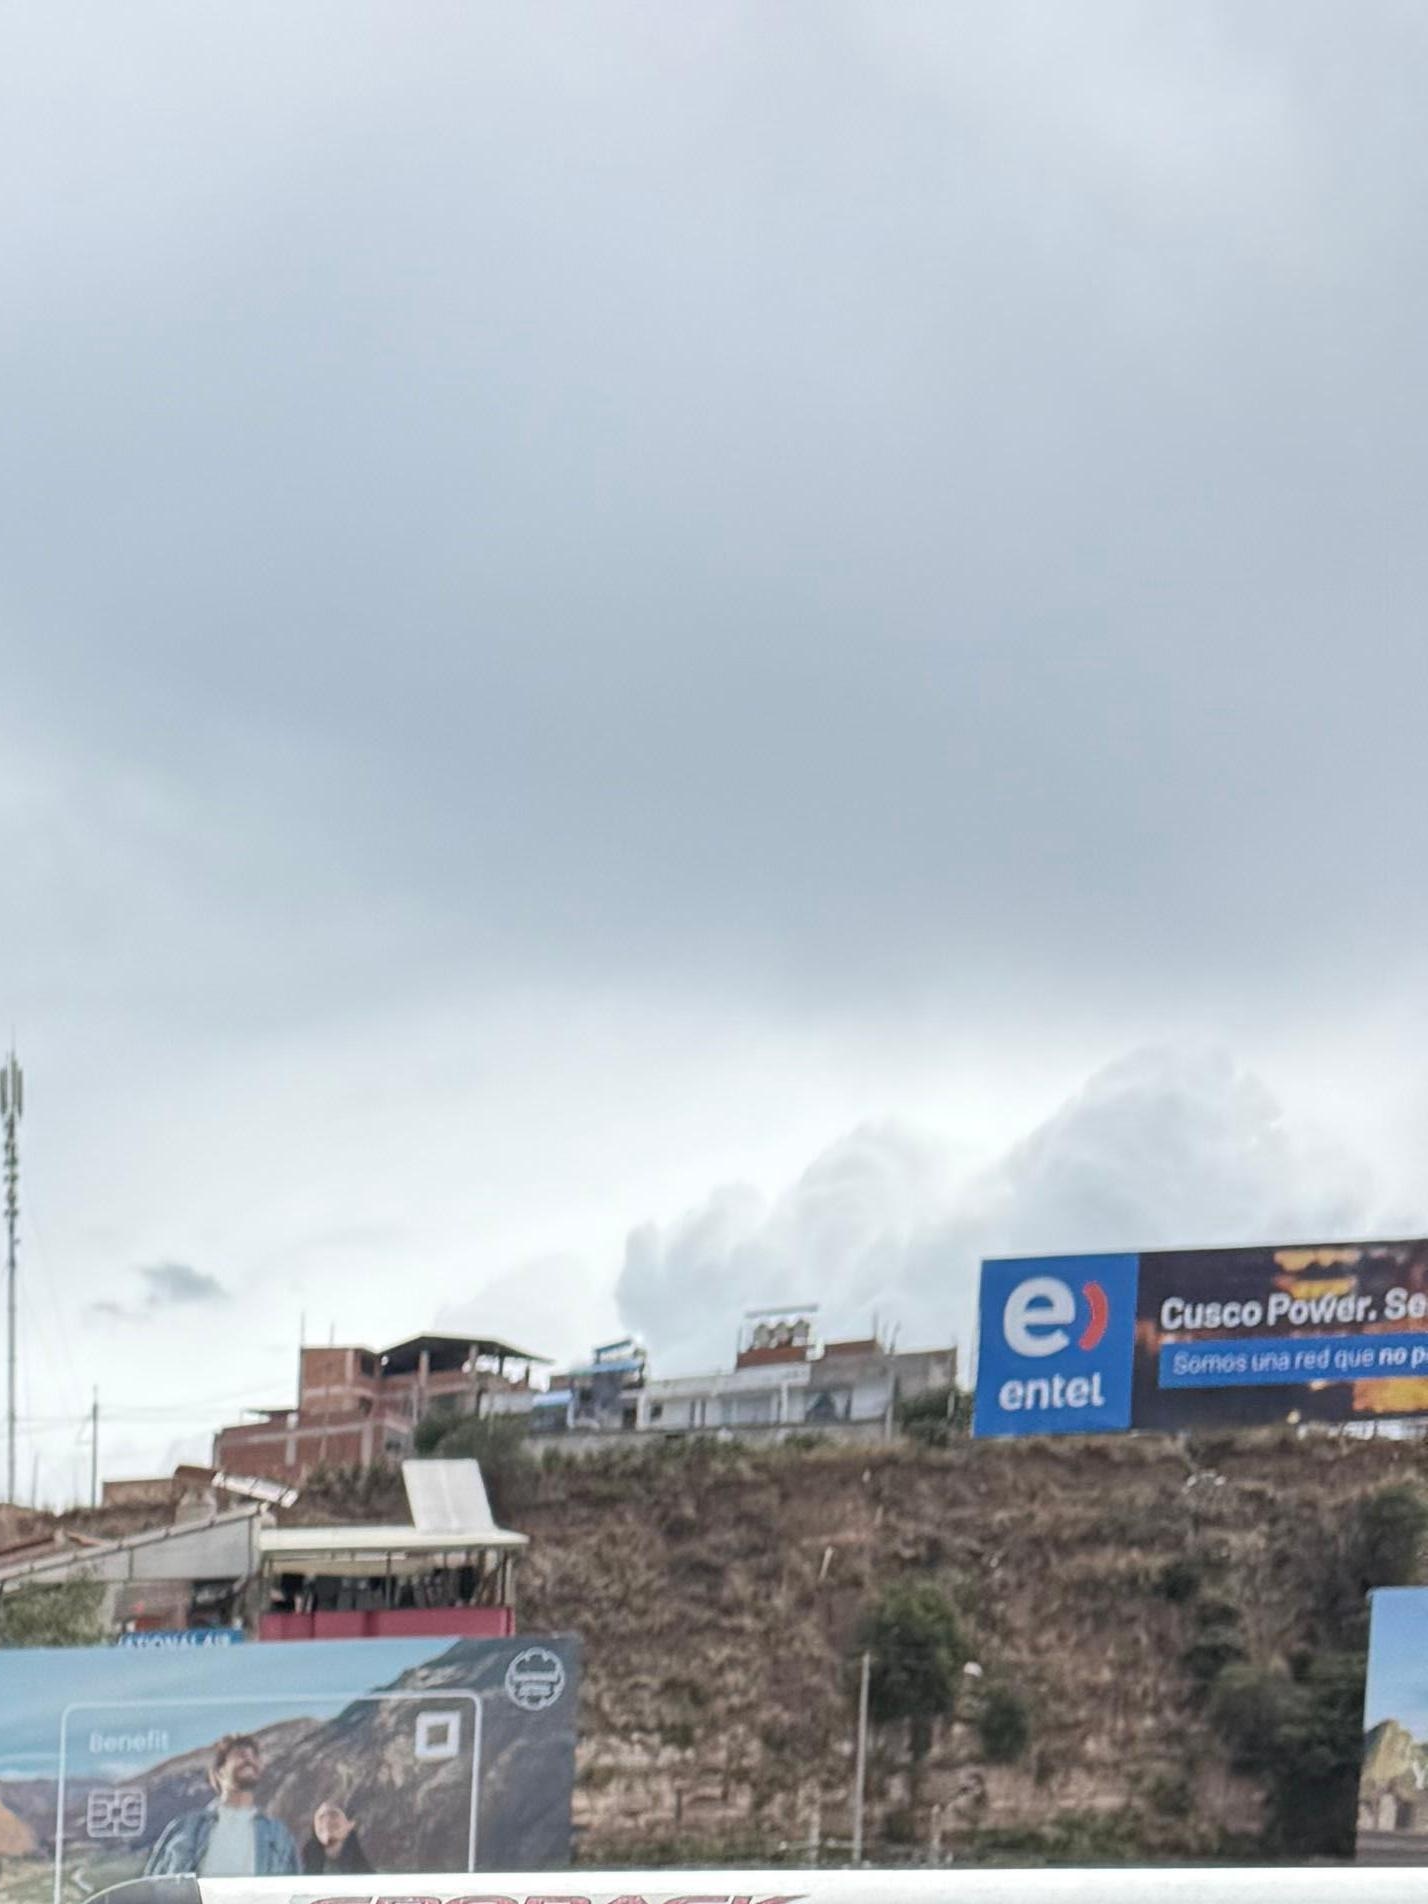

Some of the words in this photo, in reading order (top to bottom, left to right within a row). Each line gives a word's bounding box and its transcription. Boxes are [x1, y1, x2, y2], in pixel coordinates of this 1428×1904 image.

[1161, 1296, 1263, 1330] Cusco
[1267, 1292, 1377, 1327] Power.
[1172, 1350, 1247, 1375] Somos
[1251, 1351, 1289, 1372] una
[1295, 1345, 1330, 1369] red
[1334, 1350, 1374, 1372] que
[1379, 1347, 1407, 1366] no
[999, 1373, 1105, 1411] entel
